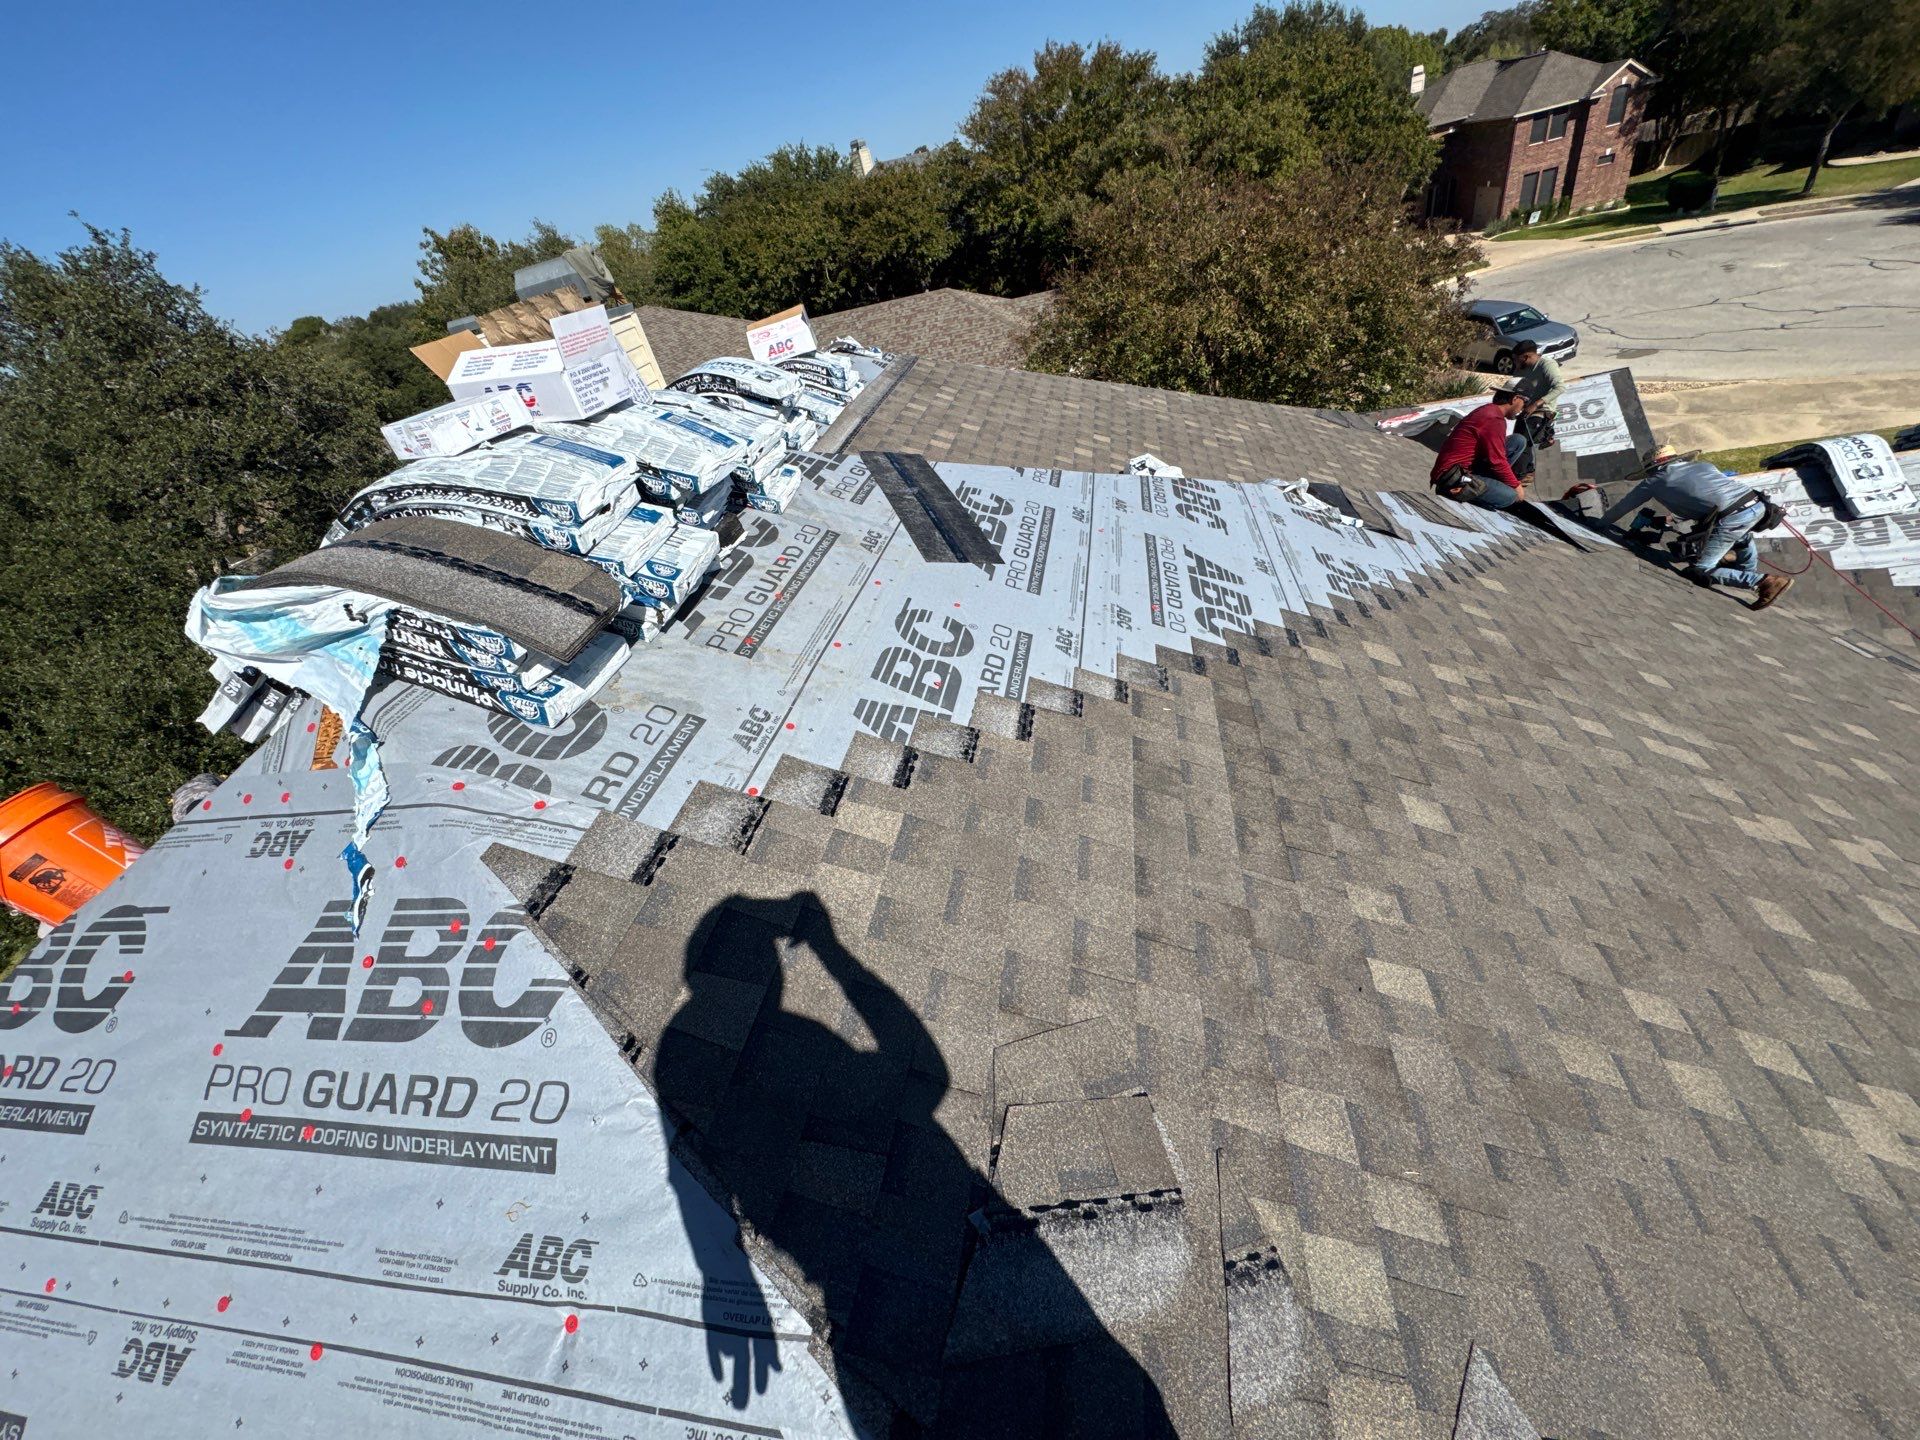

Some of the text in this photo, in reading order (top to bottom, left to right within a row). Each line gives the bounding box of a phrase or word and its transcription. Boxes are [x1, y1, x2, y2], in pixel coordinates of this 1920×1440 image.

[767, 338, 795, 358] ABC
[582, 370, 600, 382] ROOFING
[1556, 397, 1607, 425] BC
[830, 473, 855, 500] PRO
[1149, 475, 1167, 504] GUARD
[539, 499, 570, 512] ATLAS
[859, 526, 885, 555] ABC
[1005, 500, 1040, 591] PRO GUARD 20
[1031, 561, 1043, 593] SYNTHETIC
[1037, 540, 1048, 562] ROOFING
[639, 578, 665, 590] ATLAS
[705, 608, 755, 651] PRO
[744, 545, 804, 606] GUARD
[794, 523, 823, 545] 20
[739, 607, 779, 659] SYNTHETIC
[772, 576, 802, 613] ROOFING
[796, 528, 837, 582] UNDERLAYMENT
[1156, 534, 1187, 636] PRO GUARD 20
[1116, 605, 1133, 633] ABC
[1053, 625, 1075, 658] ABC
[853, 598, 975, 742] ABC
[978, 623, 1013, 698] ARD 20
[1009, 631, 1030, 699] UNDERLAYMENT
[401, 665, 495, 707] Pinnacle
[504, 692, 535, 710] ATLAS
[629, 704, 678, 747] 20
[738, 703, 774, 756] ABC
[617, 716, 704, 819] UNDERLAYMENT
[288, 817, 315, 829] Supply
[246, 829, 314, 858] ABC
[0, 904, 170, 1034] BC
[225, 896, 572, 1049] ABC
[60, 1058, 117, 1095] 20
[204, 1064, 571, 1126] PRO GUARD 20
[0, 1103, 89, 1129] ERLAYMENT
[196, 1118, 554, 1167] SYNTHETIC ROOFING UNDERLAYMENT
[31, 1180, 104, 1221] ABC
[30, 1216, 59, 1234] Supply
[58, 1219, 73, 1233] Co.
[494, 1233, 600, 1284] ABC
[497, 1279, 540, 1300] Supply
[541, 1283, 565, 1299] Co.
[148, 1322, 163, 1338] Co.
[164, 1324, 199, 1344] Supply
[722, 1311, 782, 1327] OVERLAP LINE
[111, 1339, 197, 1387] ABC
[393, 1366, 445, 1385] SUPERPOSICIÓN
[452, 1378, 473, 1392] LÍNEA
[500, 1388, 550, 1407] OVERLAP LINE
